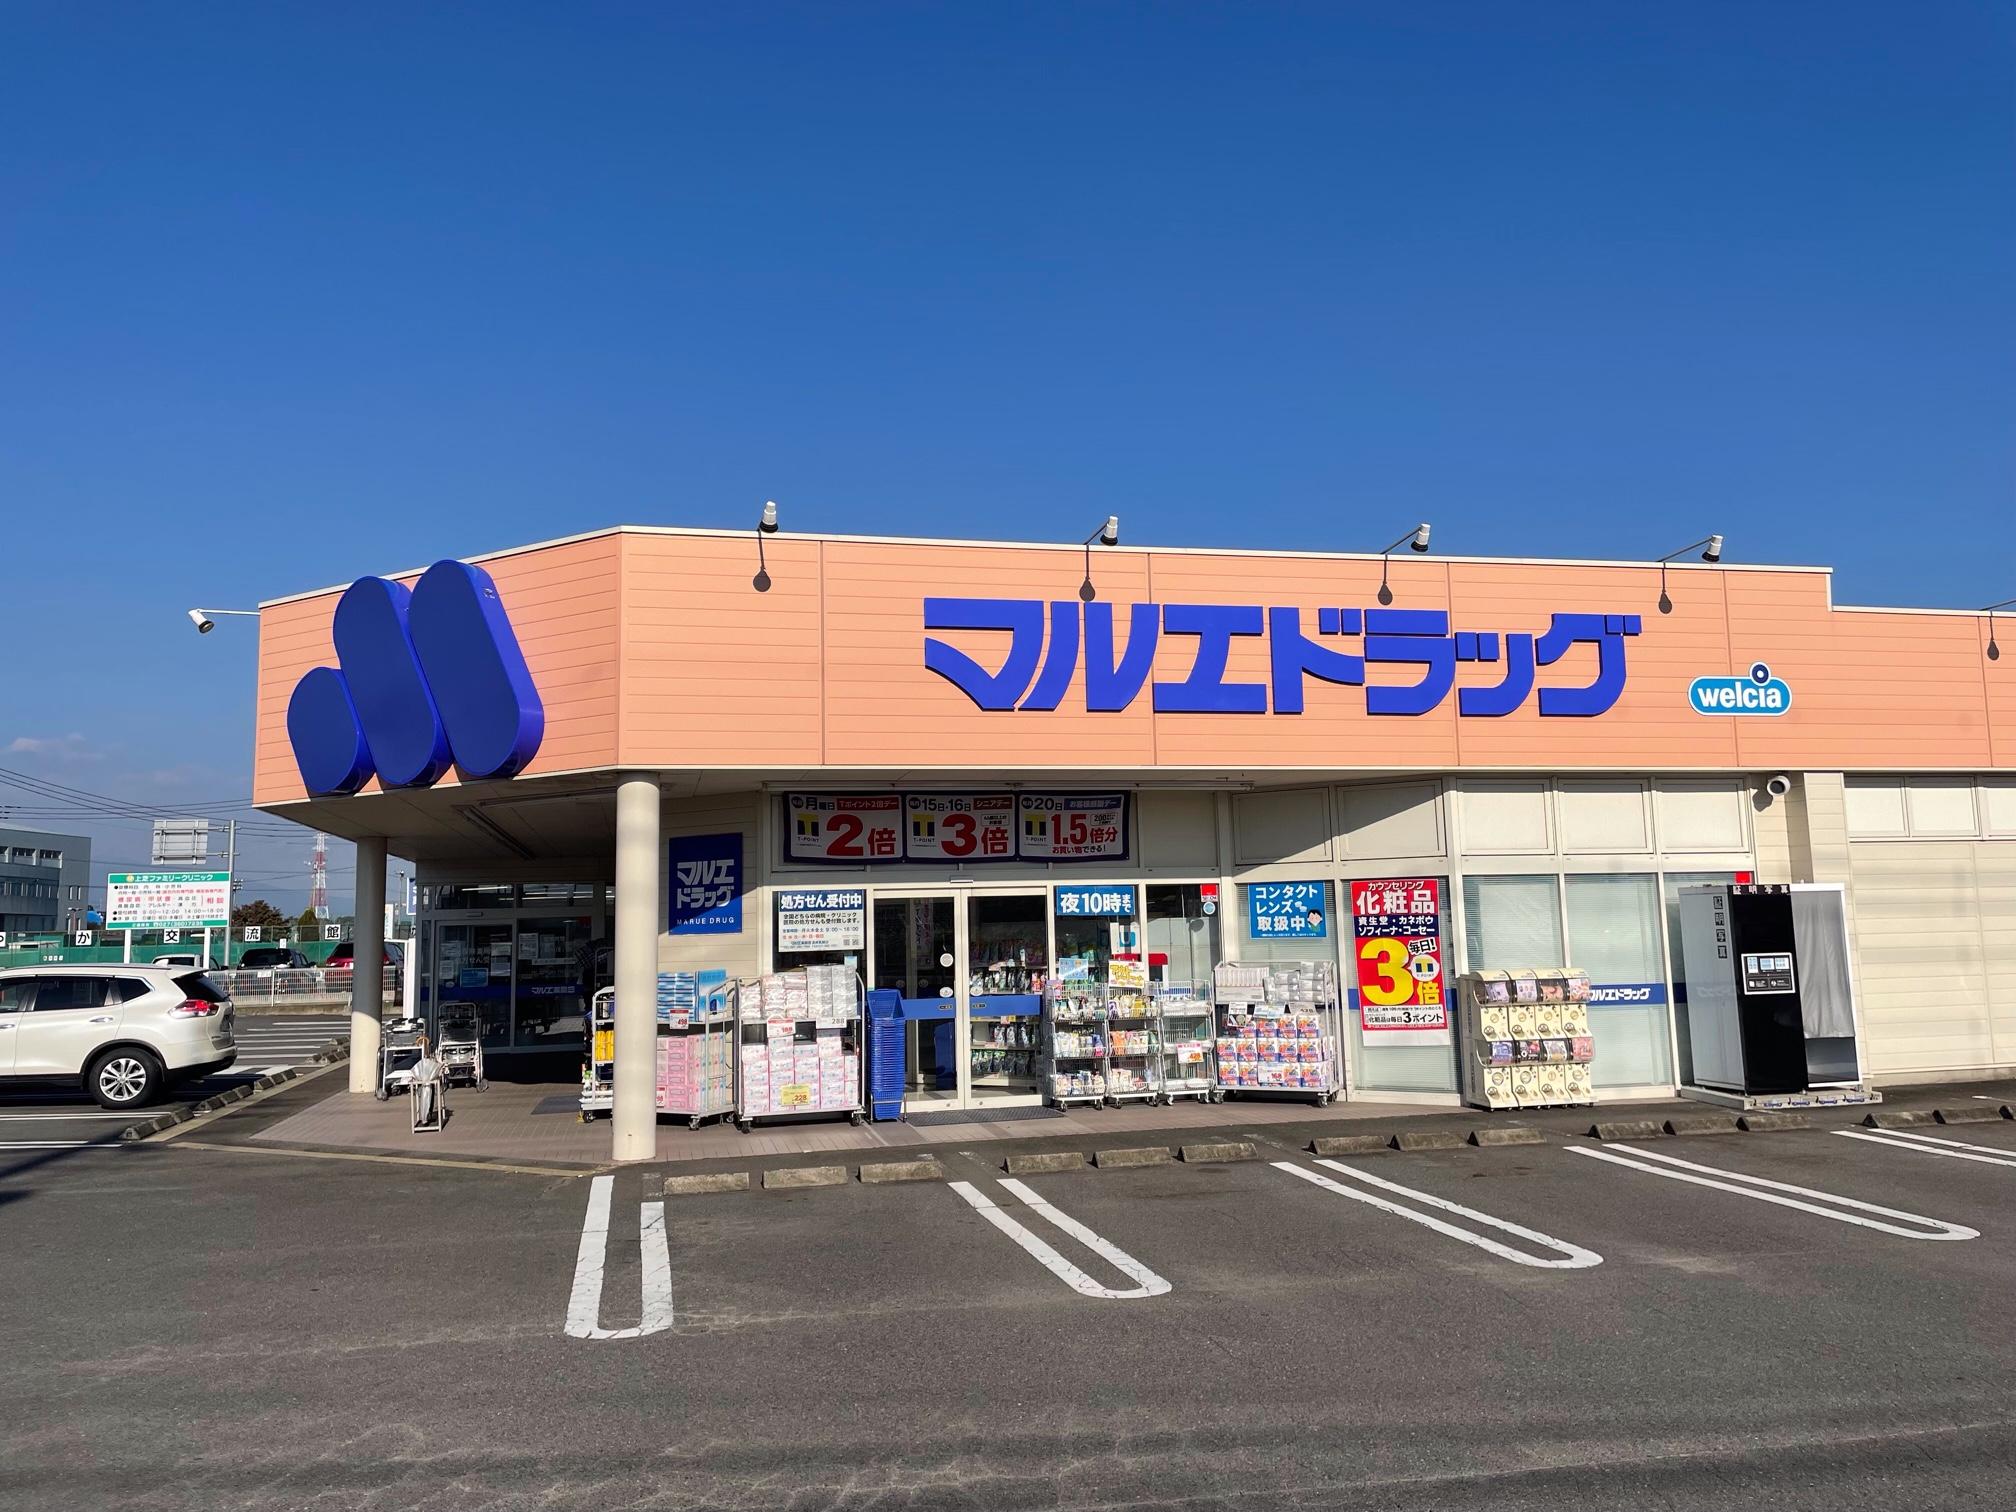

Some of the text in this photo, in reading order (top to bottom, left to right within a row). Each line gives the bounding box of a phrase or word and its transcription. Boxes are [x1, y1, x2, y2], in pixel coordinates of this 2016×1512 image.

[924, 597, 1642, 717] マルエドラッグ
[1697, 671, 1783, 709] welcia
[840, 799, 898, 809] Tポイント2倍デー
[976, 799, 1010, 808] シニアデー
[1034, 798, 1062, 811] 20日
[676, 858, 735, 886] マルエ
[1255, 884, 1318, 899] コンタクト
[1367, 880, 1424, 891] カウンセリング
[1733, 885, 1789, 895] 証明写真
[676, 885, 735, 909] ドラッグ
[780, 892, 862, 910] 処方せん受付中
[1060, 892, 1132, 913] 夜10時まで
[1356, 889, 1435, 915] 化粧品
[1256, 899, 1294, 914] レンズ
[676, 916, 735, 926] MARUE DRUG
[1257, 915, 1306, 931] 取扱中
[1358, 915, 1434, 926] 資生堂・カネボウ
[1359, 925, 1436, 937] ソフィーナ・コーセー
[531, 986, 576, 994] マルエ
